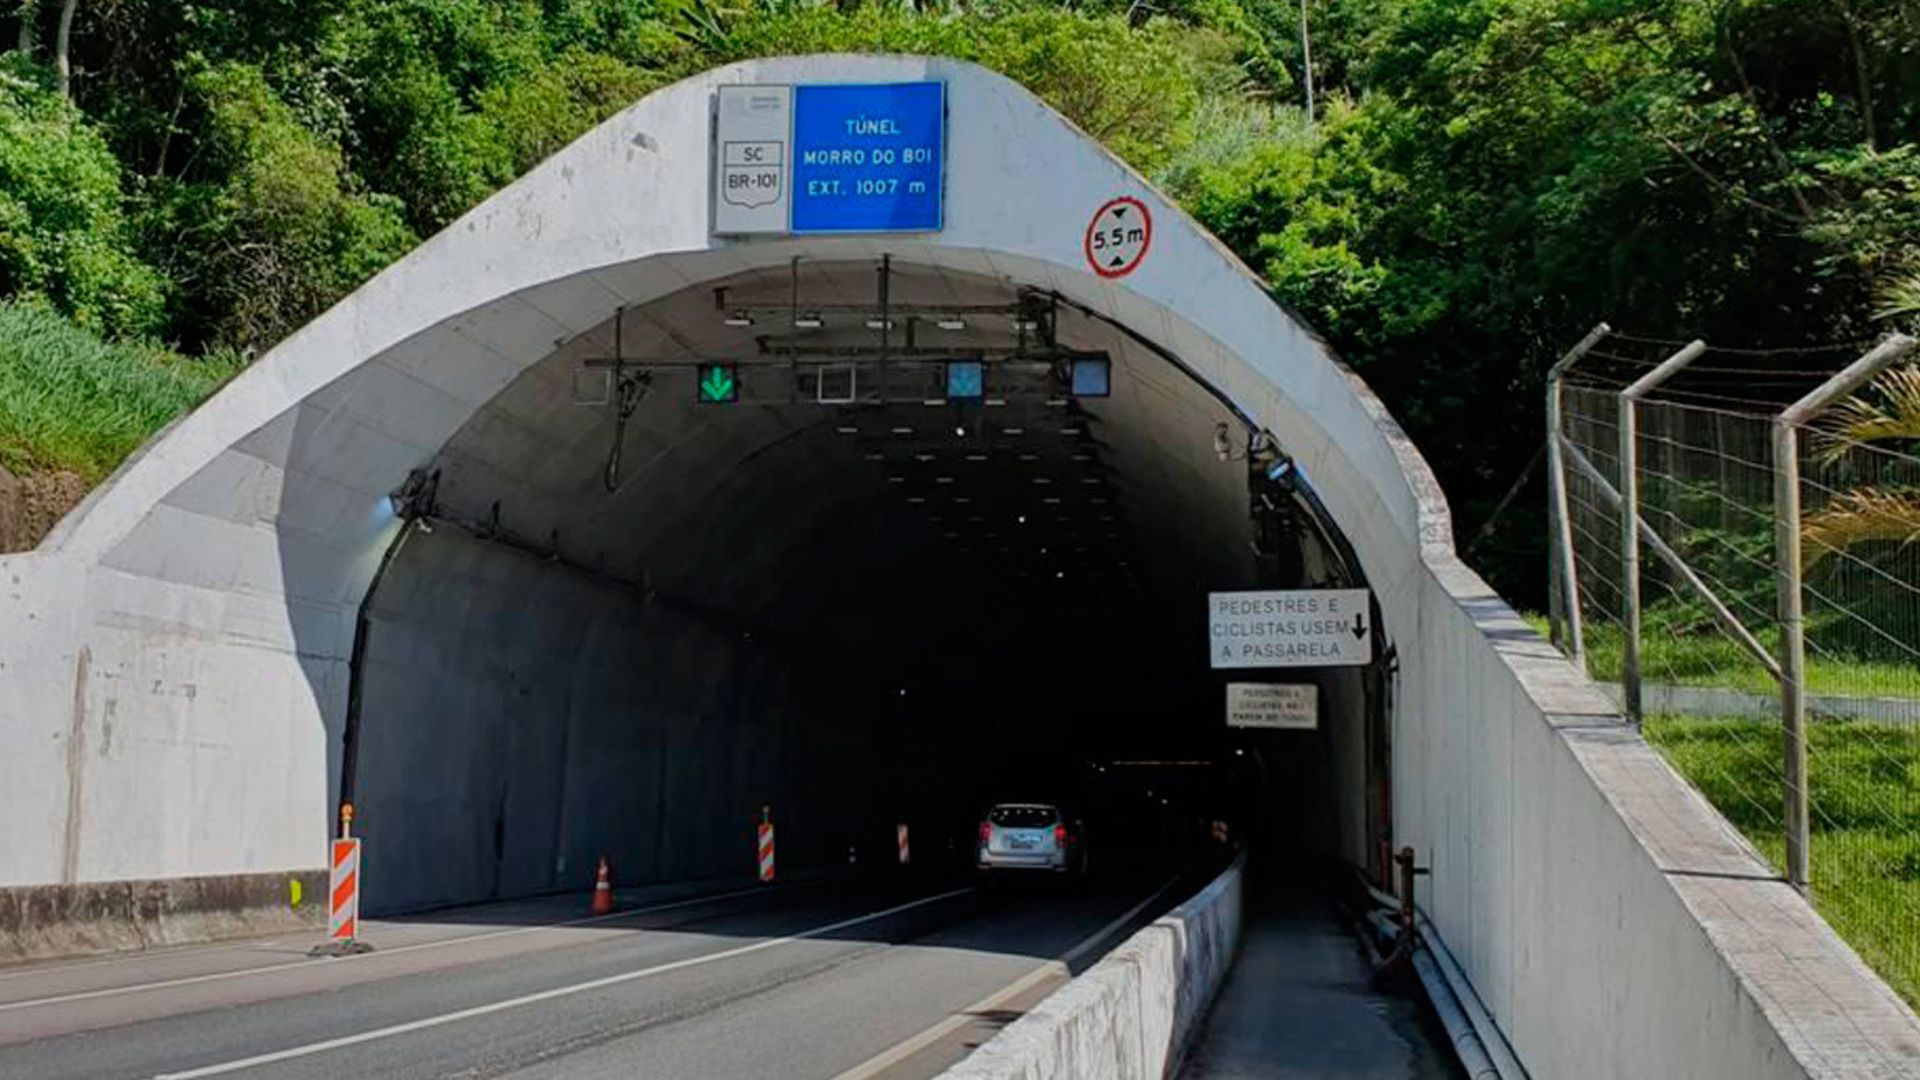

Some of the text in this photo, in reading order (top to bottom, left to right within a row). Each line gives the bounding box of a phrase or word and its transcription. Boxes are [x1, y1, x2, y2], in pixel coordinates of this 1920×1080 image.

[846, 115, 900, 135] TÚNEL
[743, 148, 763, 162] SC
[803, 148, 932, 165] MORRO DO BOI
[728, 173, 777, 189] BR-101
[808, 179, 926, 196] EXT. 1007 m
[1218, 598, 1340, 615] PEDESTRES E
[1212, 620, 1349, 638] CICLISTAS USEM
[1221, 643, 1342, 658] A PASSARELA
